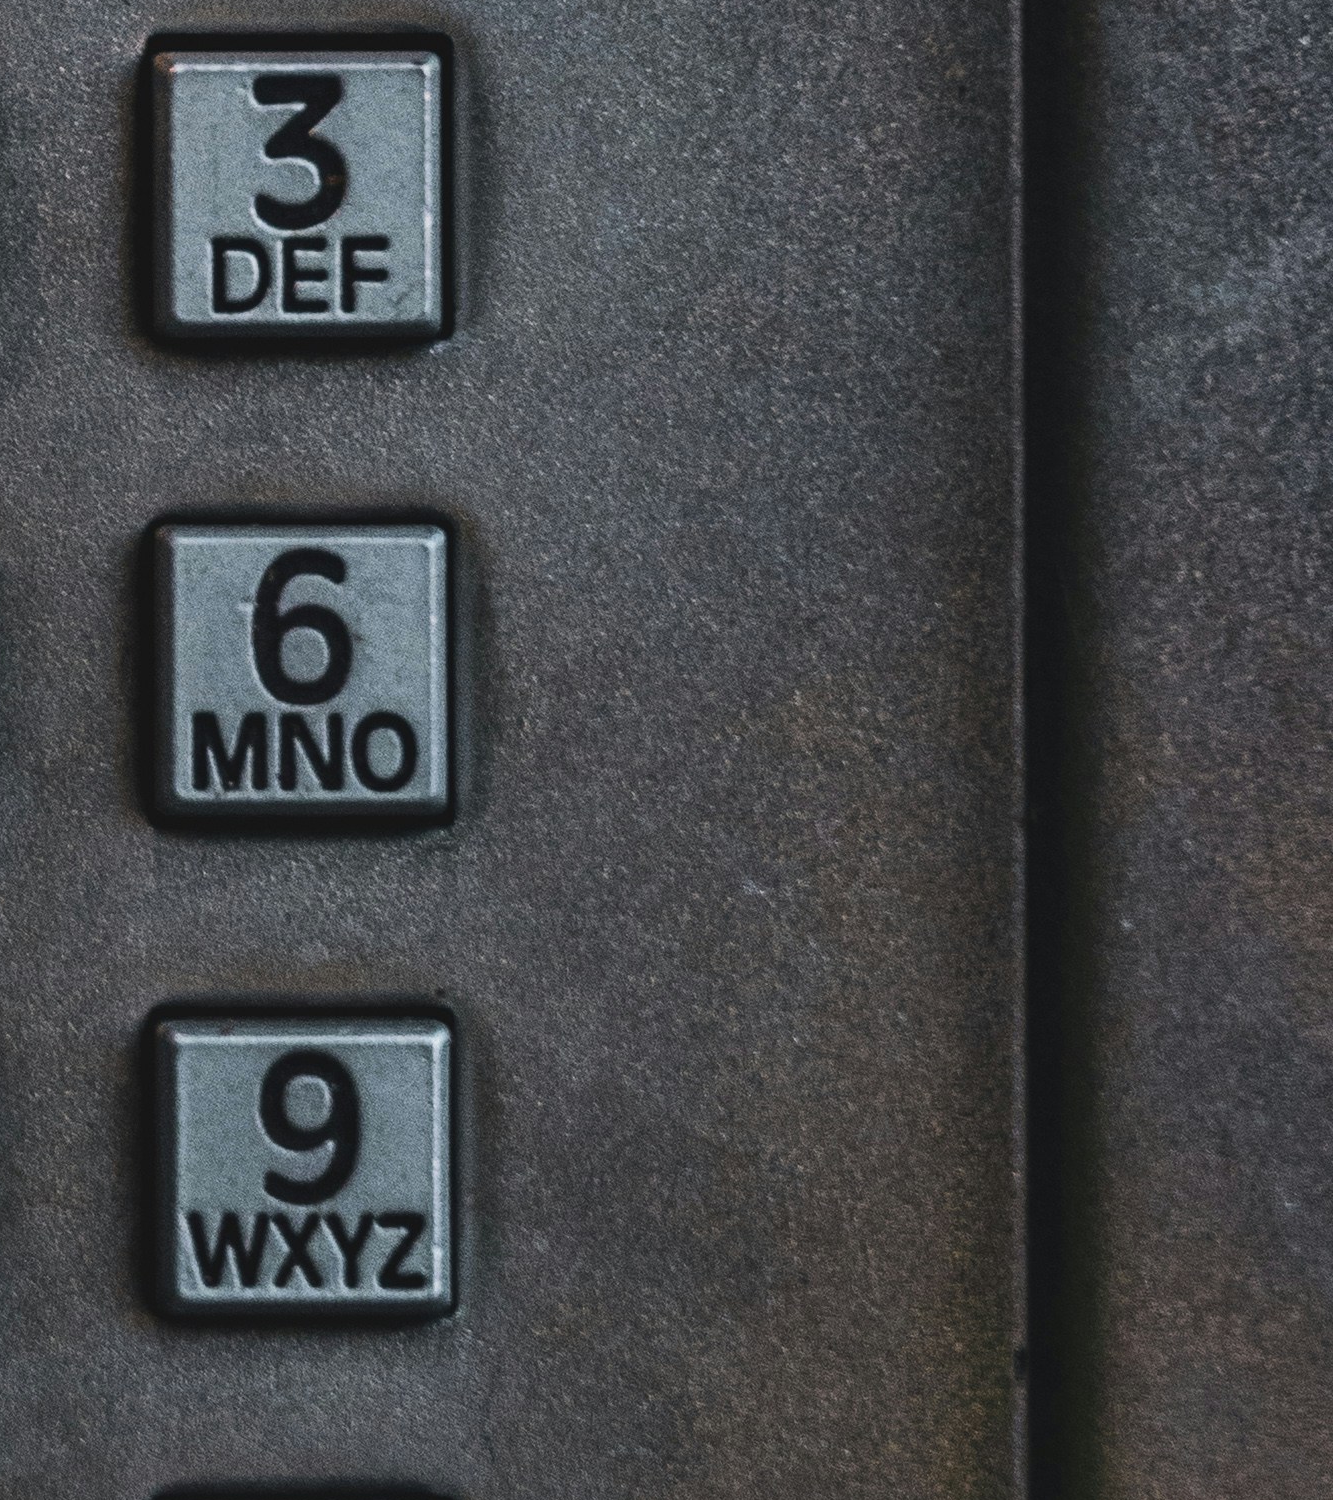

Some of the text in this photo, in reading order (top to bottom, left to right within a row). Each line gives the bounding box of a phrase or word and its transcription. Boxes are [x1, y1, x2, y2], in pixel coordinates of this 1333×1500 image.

[250, 71, 350, 231] 3
[209, 233, 392, 316] DEF
[249, 547, 355, 707] 6
[189, 710, 420, 796] MNO
[256, 1048, 362, 1206] 9
[185, 1210, 430, 1292] WXYZ
